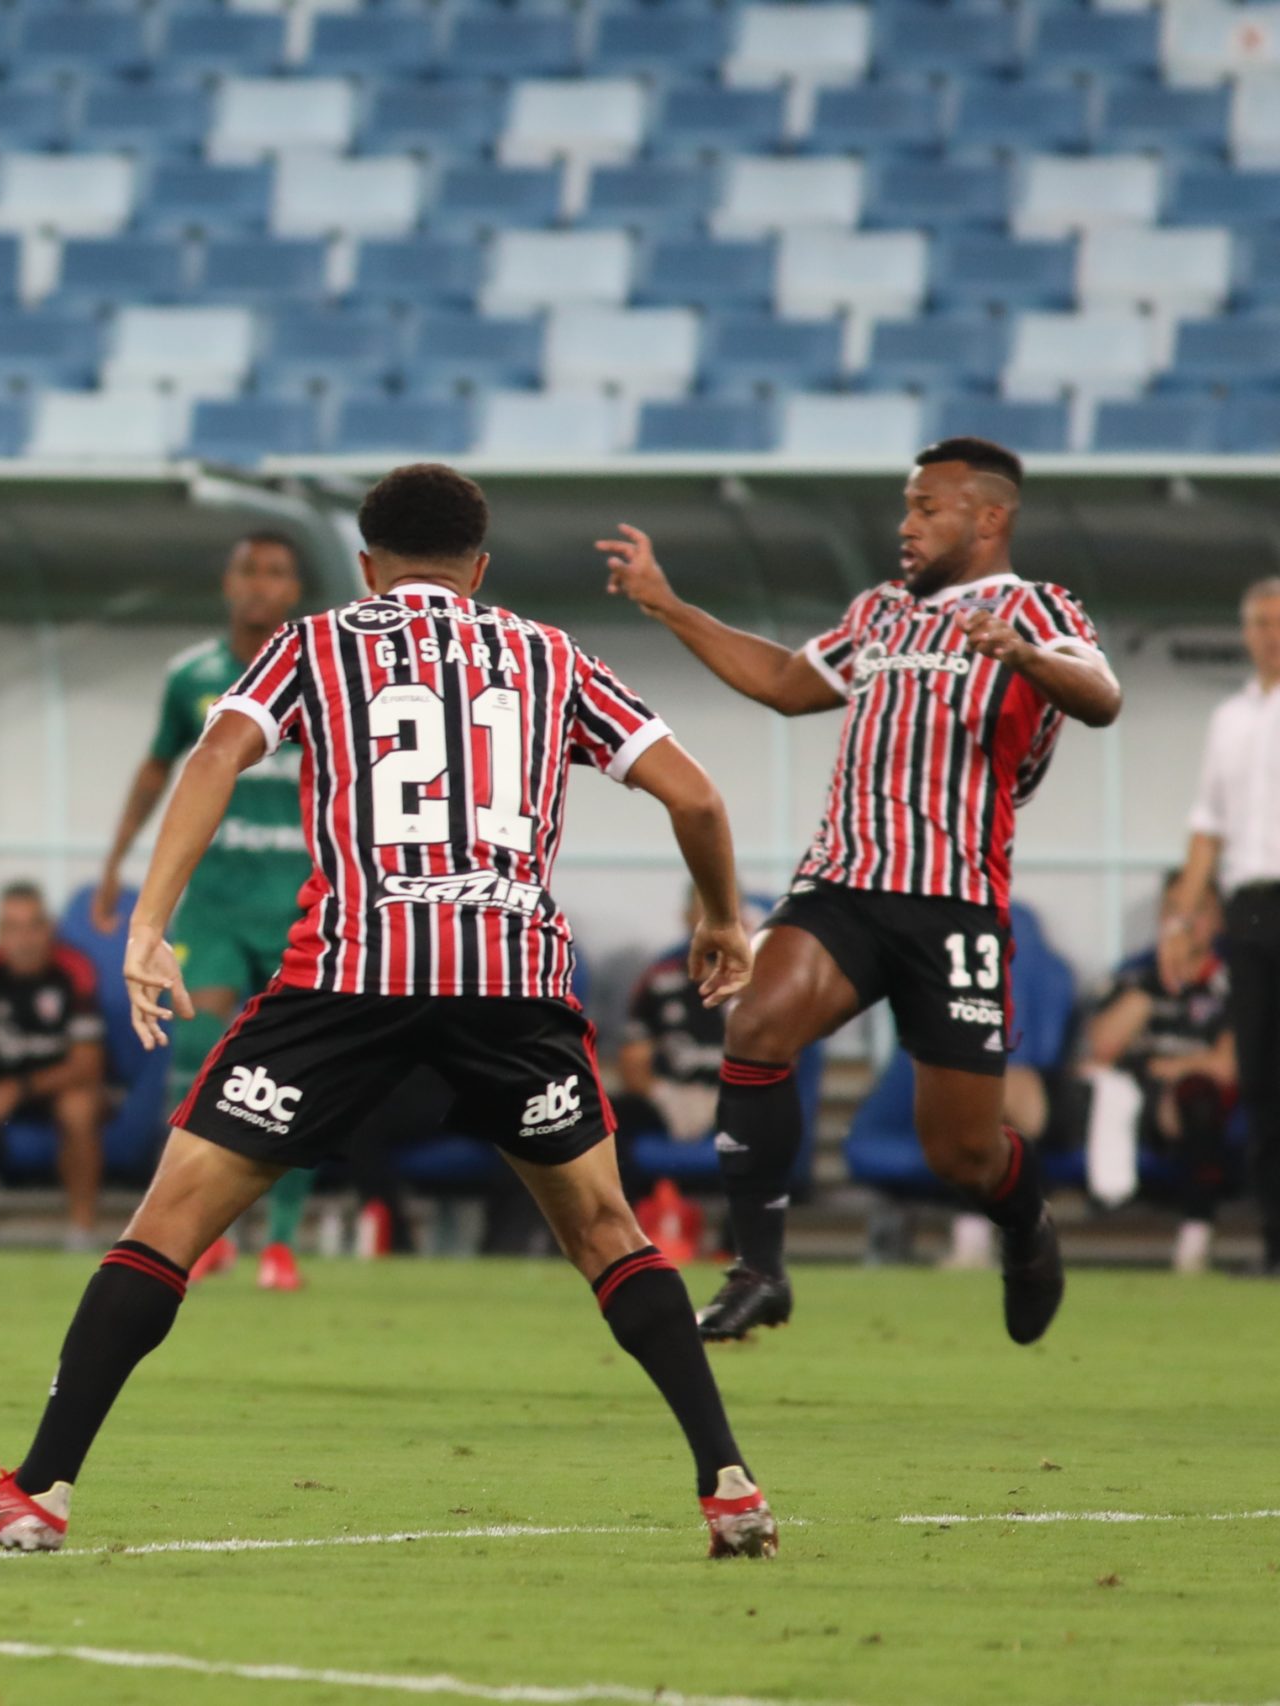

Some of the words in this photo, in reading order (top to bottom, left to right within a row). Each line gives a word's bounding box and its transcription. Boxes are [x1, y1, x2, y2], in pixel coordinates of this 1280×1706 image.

[375, 639, 411, 668] G.
[419, 636, 521, 674] SARA
[367, 683, 534, 854] 21
[378, 869, 543, 913] GAZIN
[945, 933, 1000, 989] 13
[222, 1065, 303, 1122] abc
[521, 1074, 581, 1126] abc
